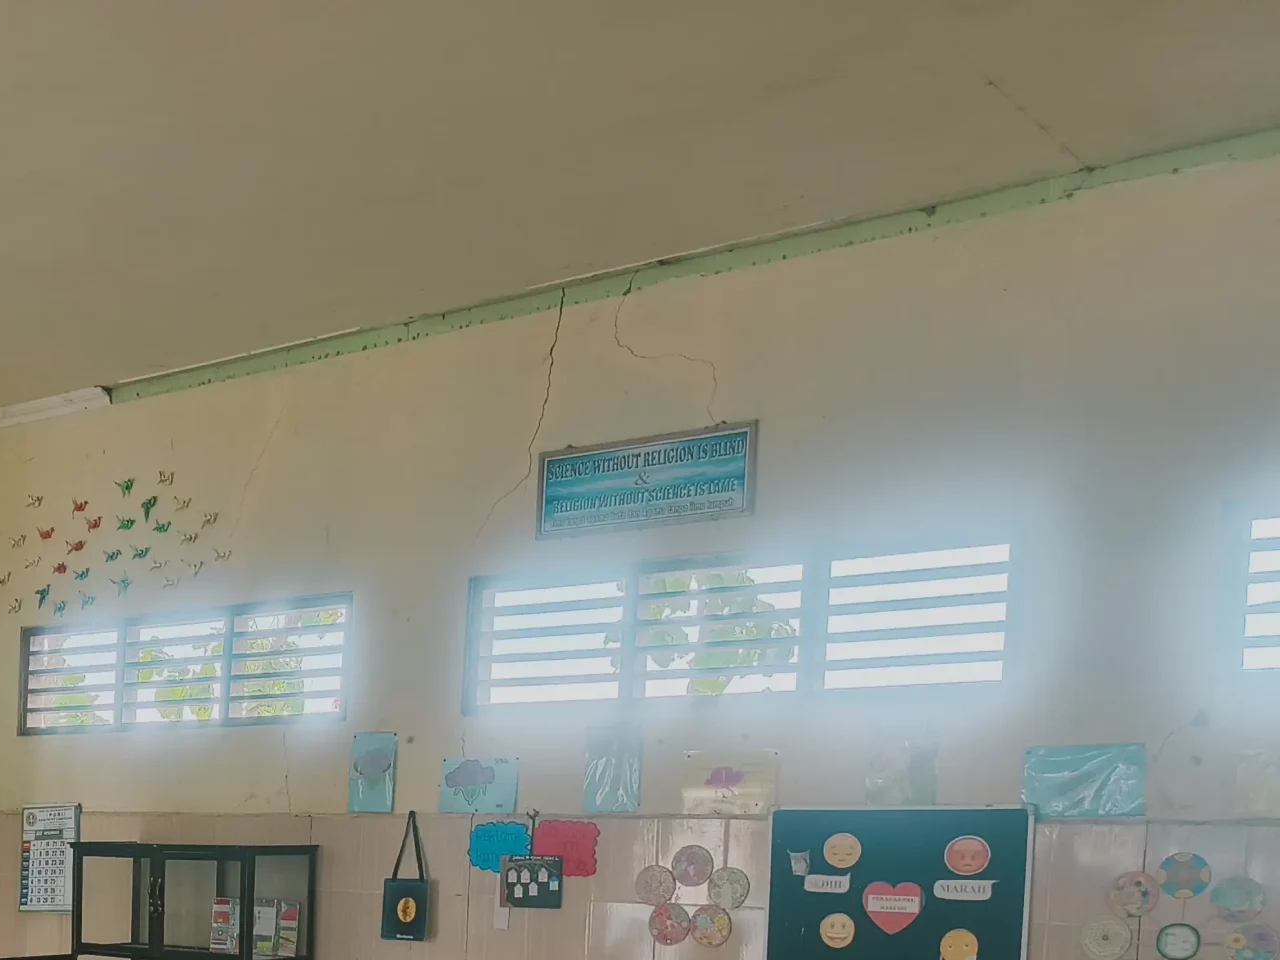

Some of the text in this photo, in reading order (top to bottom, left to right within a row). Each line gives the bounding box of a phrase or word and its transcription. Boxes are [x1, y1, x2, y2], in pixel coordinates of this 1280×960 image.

[548, 438, 745, 480] SCIENCE WITHOUT RELIGION IS BLIND
[635, 471, 650, 486] &
[553, 478, 737, 514] RELIGION WITHOUT SCIENCE IS LAME
[939, 883, 987, 895] MARAH
